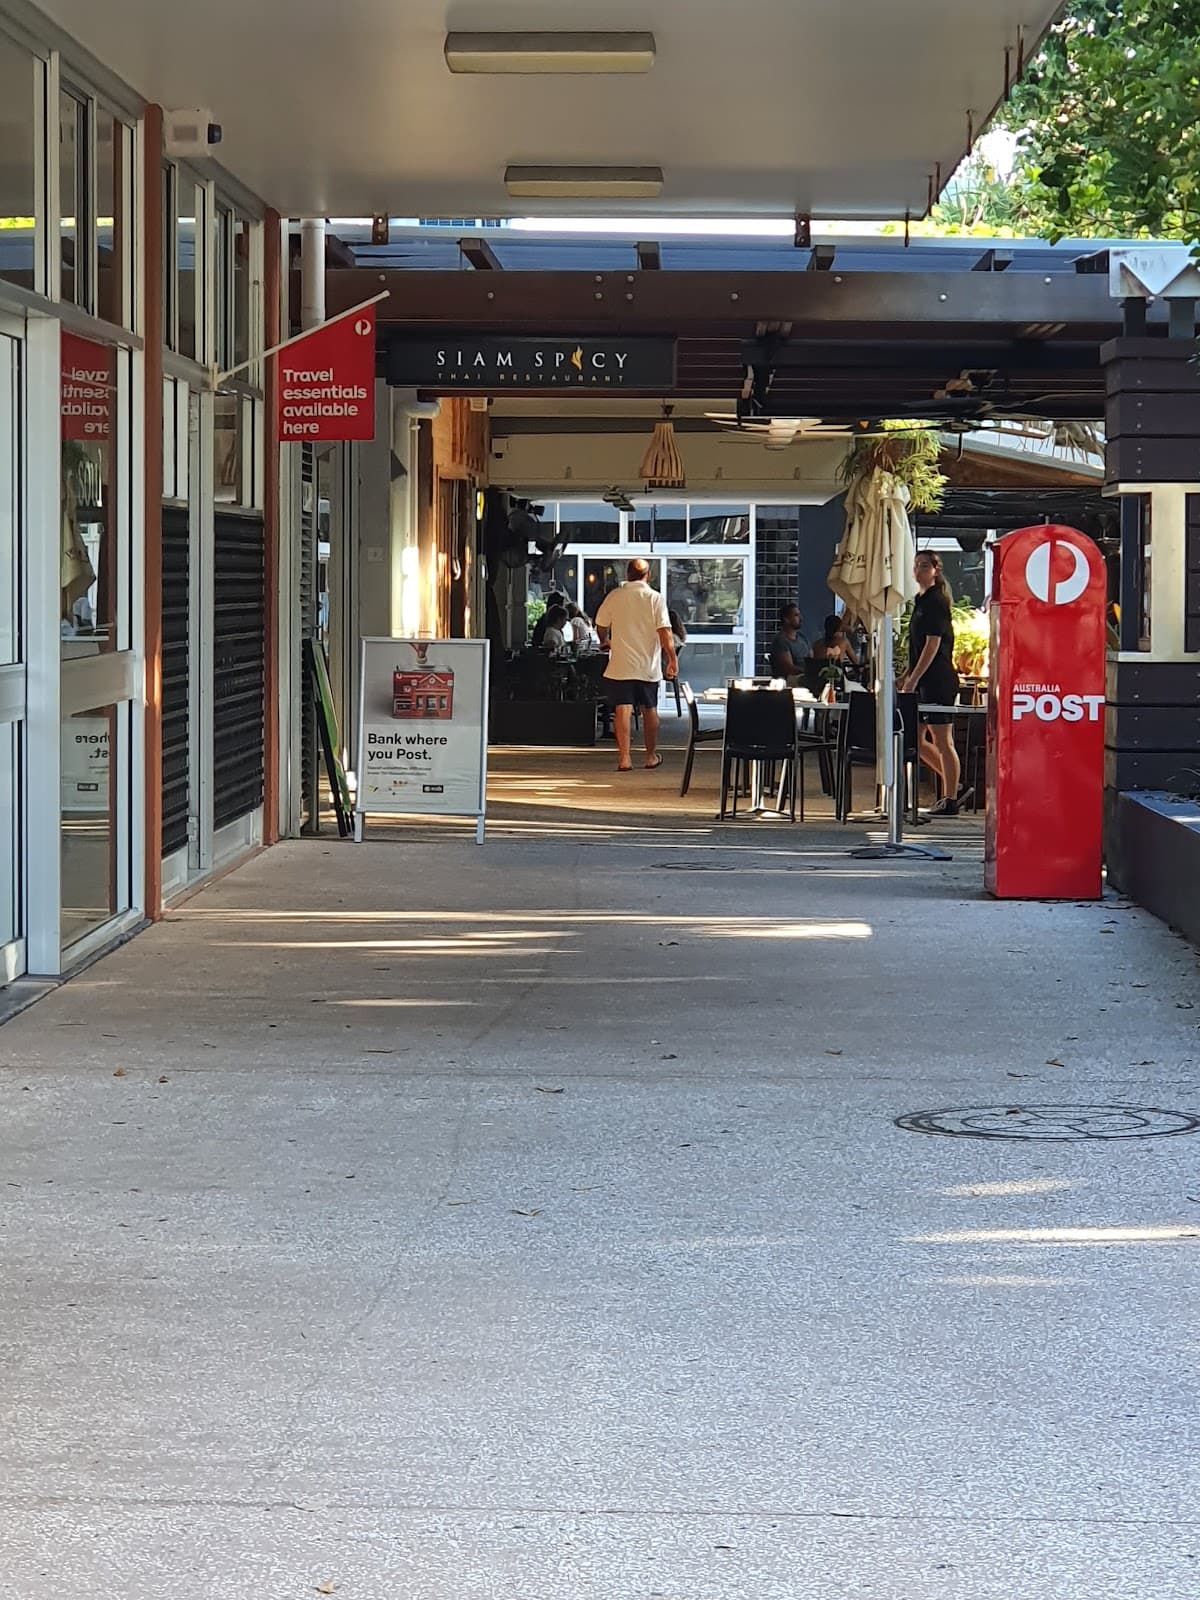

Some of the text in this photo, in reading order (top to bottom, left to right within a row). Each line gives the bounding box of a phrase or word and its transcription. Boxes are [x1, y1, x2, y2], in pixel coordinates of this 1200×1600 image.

[436, 350, 513, 366] SIAM
[282, 367, 334, 382] Travel
[438, 372, 623, 382] THAI RESTAURANT
[282, 385, 367, 399] essentials
[283, 402, 359, 417] available
[283, 420, 320, 434] here
[1013, 684, 1060, 693] AUSTRALIA
[1012, 694, 1105, 721] POST
[367, 732, 448, 745] Bank where
[367, 748, 432, 761] you Post.
